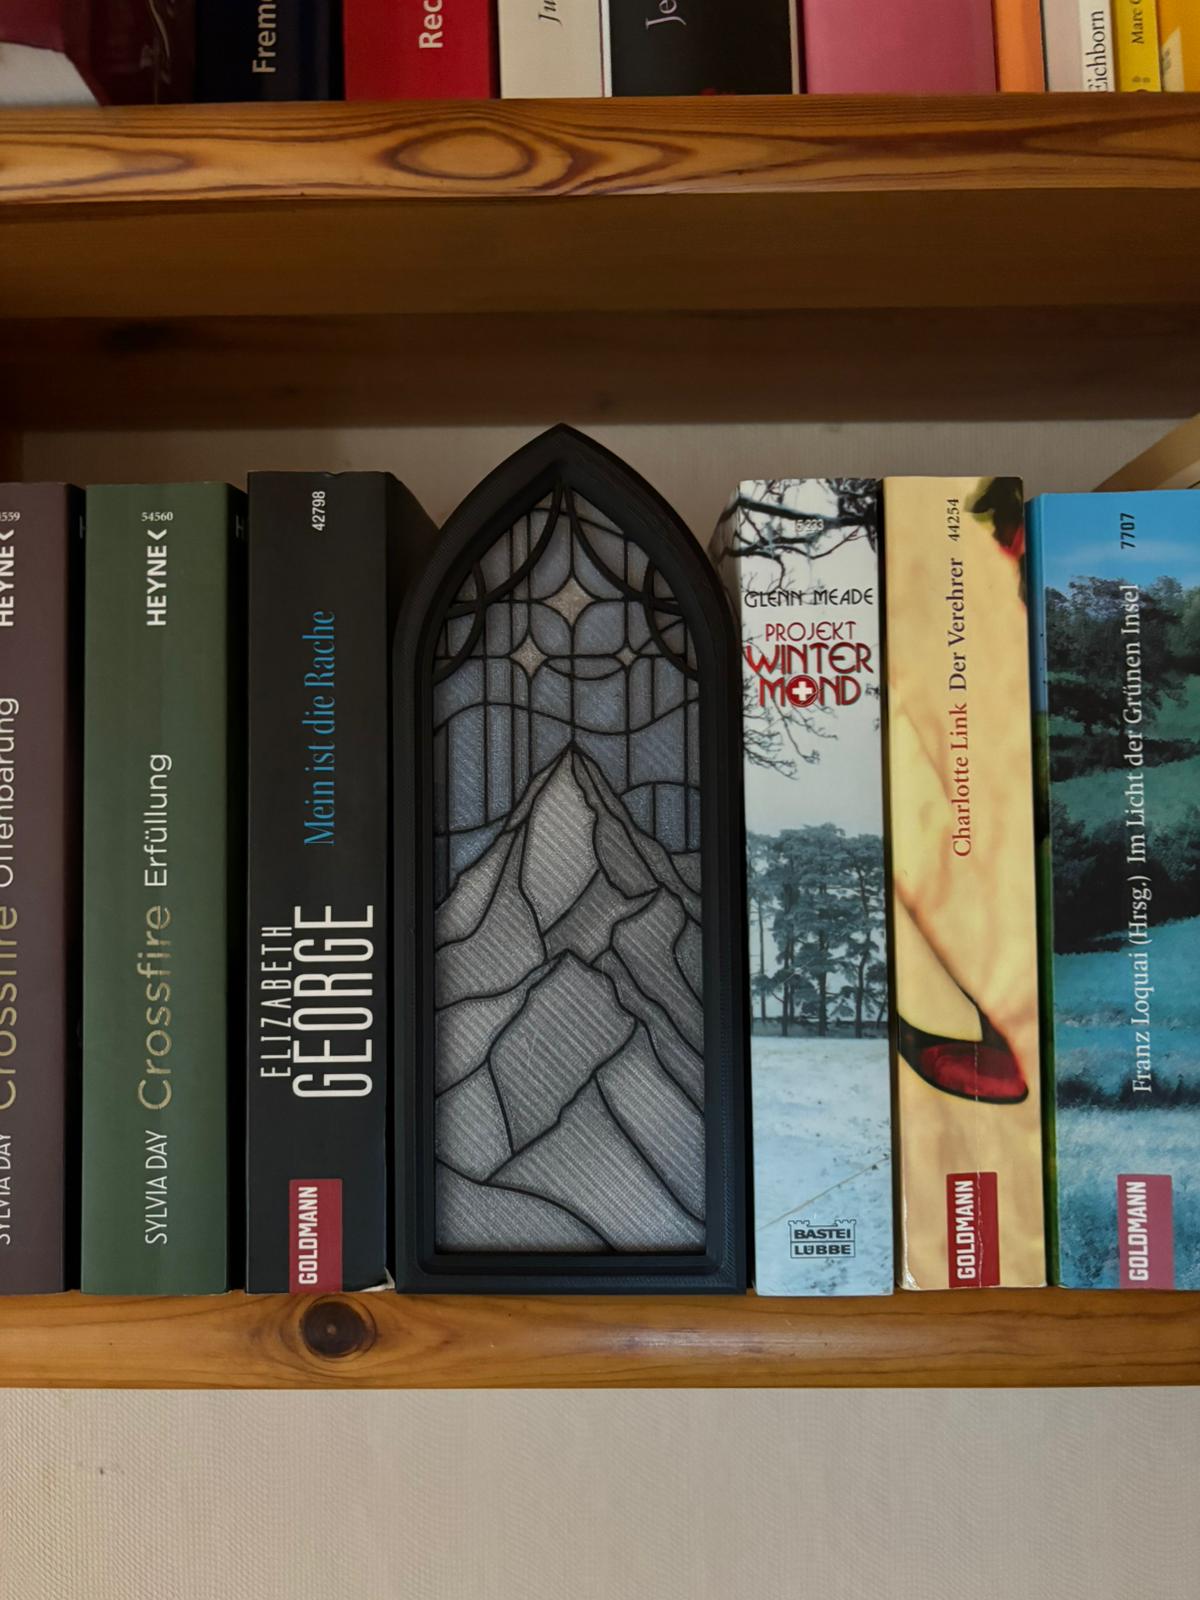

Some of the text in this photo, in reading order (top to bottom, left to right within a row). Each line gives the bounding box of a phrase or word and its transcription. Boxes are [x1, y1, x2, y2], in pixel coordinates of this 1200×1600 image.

[252, 0, 276, 73] Frem
[645, 0, 686, 29] Je
[0, 511, 21, 522] 559
[141, 511, 174, 522] 54560
[311, 490, 326, 531] 42798
[946, 498, 960, 542] 44254
[1119, 512, 1136, 550] 7707
[0, 545, 15, 627] HEYNE
[146, 545, 167, 626] HEYNE
[744, 588, 874, 608] GLENN MEADE
[745, 642, 874, 675] WINTER
[765, 621, 857, 642] PROJEKT
[301, 611, 336, 845] Mein ist die Rache
[946, 557, 971, 857] Charlotte Link Der Verehrer
[1120, 584, 1155, 1092] Franz Loquai (Hrsg.) Im Licht der Grünen Insel
[137, 754, 172, 1110] Crossfire Erfüllung
[260, 926, 293, 1078] ELIZABETH
[292, 905, 374, 1098] GEORGE
[144, 1130, 168, 1245] SYLVIA DAY
[298, 1186, 318, 1285] GOLDMANN
[794, 1228, 851, 1240] BASTEI
[794, 1244, 851, 1256] LÜBBE
[954, 1180, 976, 1280] GOLDMANN
[1127, 1181, 1149, 1281] GOLDMANN
